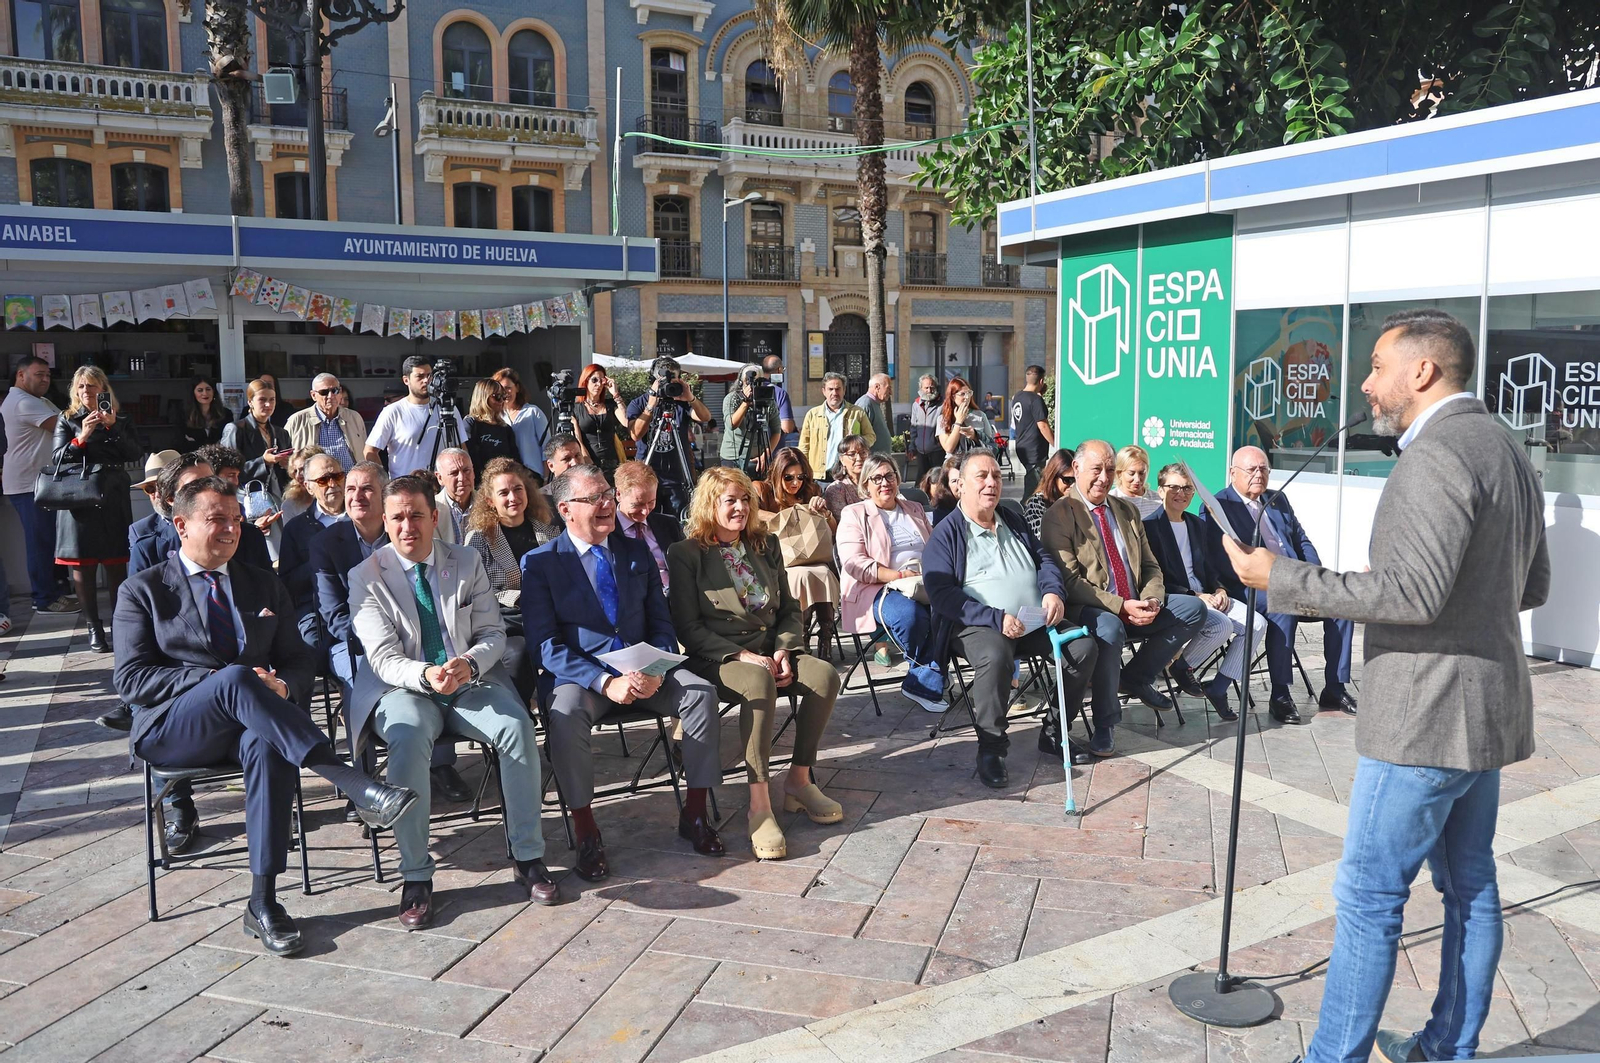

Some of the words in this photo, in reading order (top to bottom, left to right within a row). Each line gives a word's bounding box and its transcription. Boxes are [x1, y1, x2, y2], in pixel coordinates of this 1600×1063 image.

[2, 224, 77, 243] ANABEL
[344, 237, 458, 259] AYUNTAMIENTO
[462, 244, 481, 260] DE
[485, 246, 538, 263] HUELVA
[1148, 268, 1225, 305] ESPA
[1146, 346, 1218, 378] UNIA
[1287, 364, 1330, 380] ESPA
[1565, 361, 1600, 382] ES
[1286, 401, 1326, 418] UNIA
[1170, 418, 1211, 430] Universidad
[1169, 428, 1215, 440] Internacional
[1169, 437, 1179, 447] de
[1180, 438, 1215, 449] Andalucía
